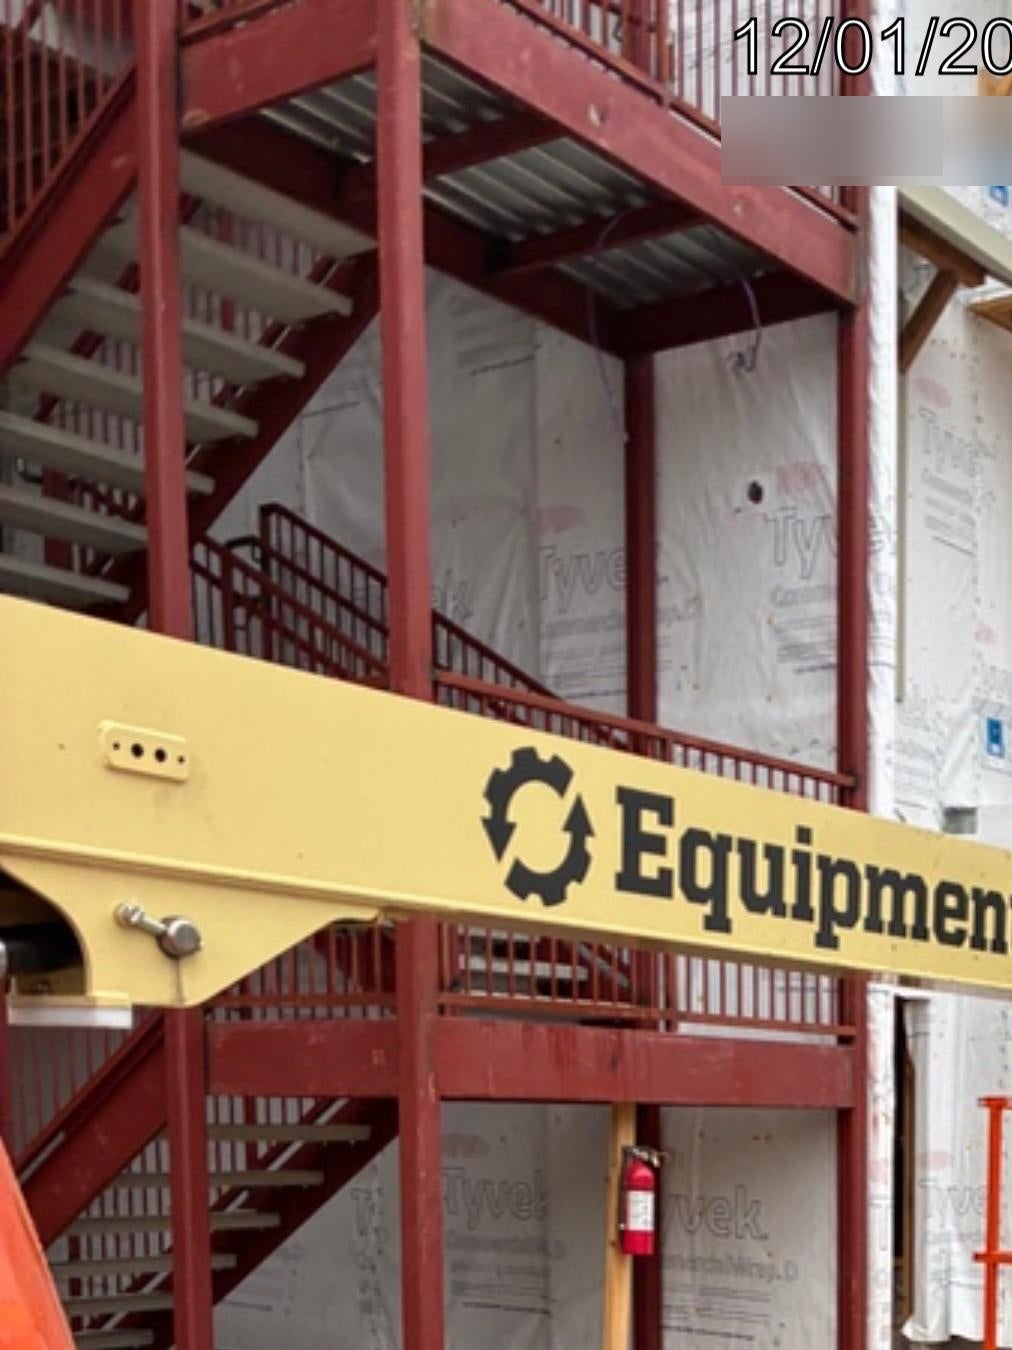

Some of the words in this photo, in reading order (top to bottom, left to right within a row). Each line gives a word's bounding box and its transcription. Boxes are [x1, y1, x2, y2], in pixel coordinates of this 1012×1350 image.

[766, 506, 837, 581] Tyv
[538, 545, 627, 612] Tyve
[664, 1183, 769, 1240] vek
